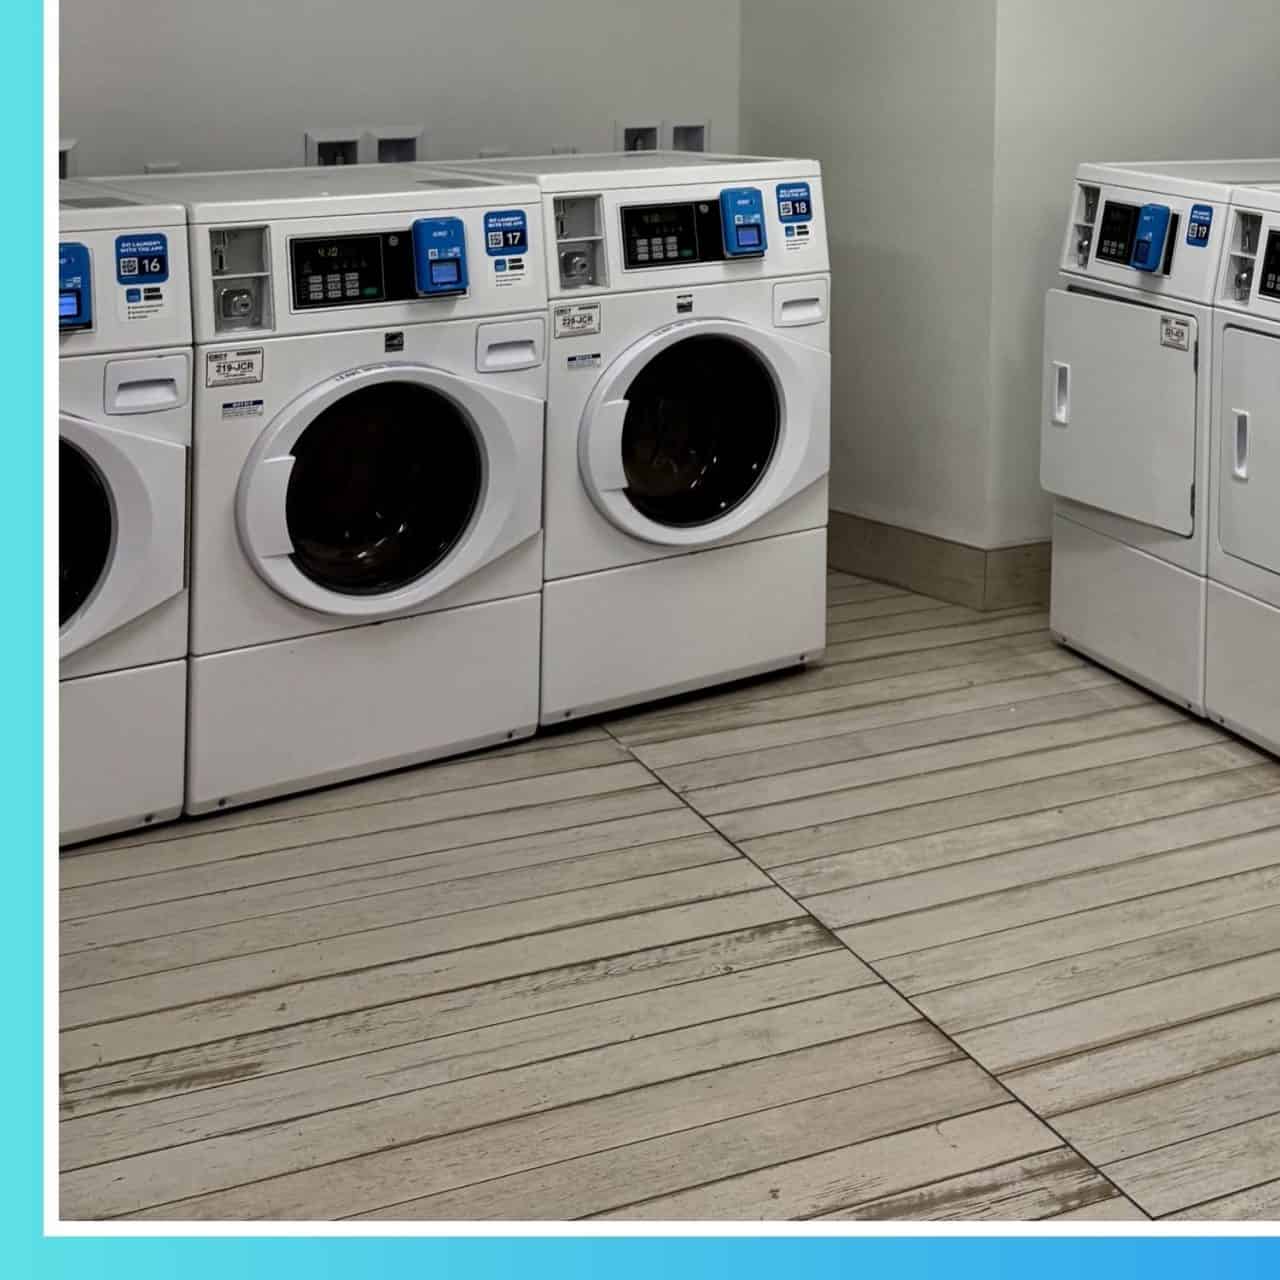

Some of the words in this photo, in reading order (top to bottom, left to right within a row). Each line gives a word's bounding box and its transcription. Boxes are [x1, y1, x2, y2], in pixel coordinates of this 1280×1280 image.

[795, 201, 807, 214] 18
[506, 232, 521, 246] 17
[142, 258, 160, 272] 16
